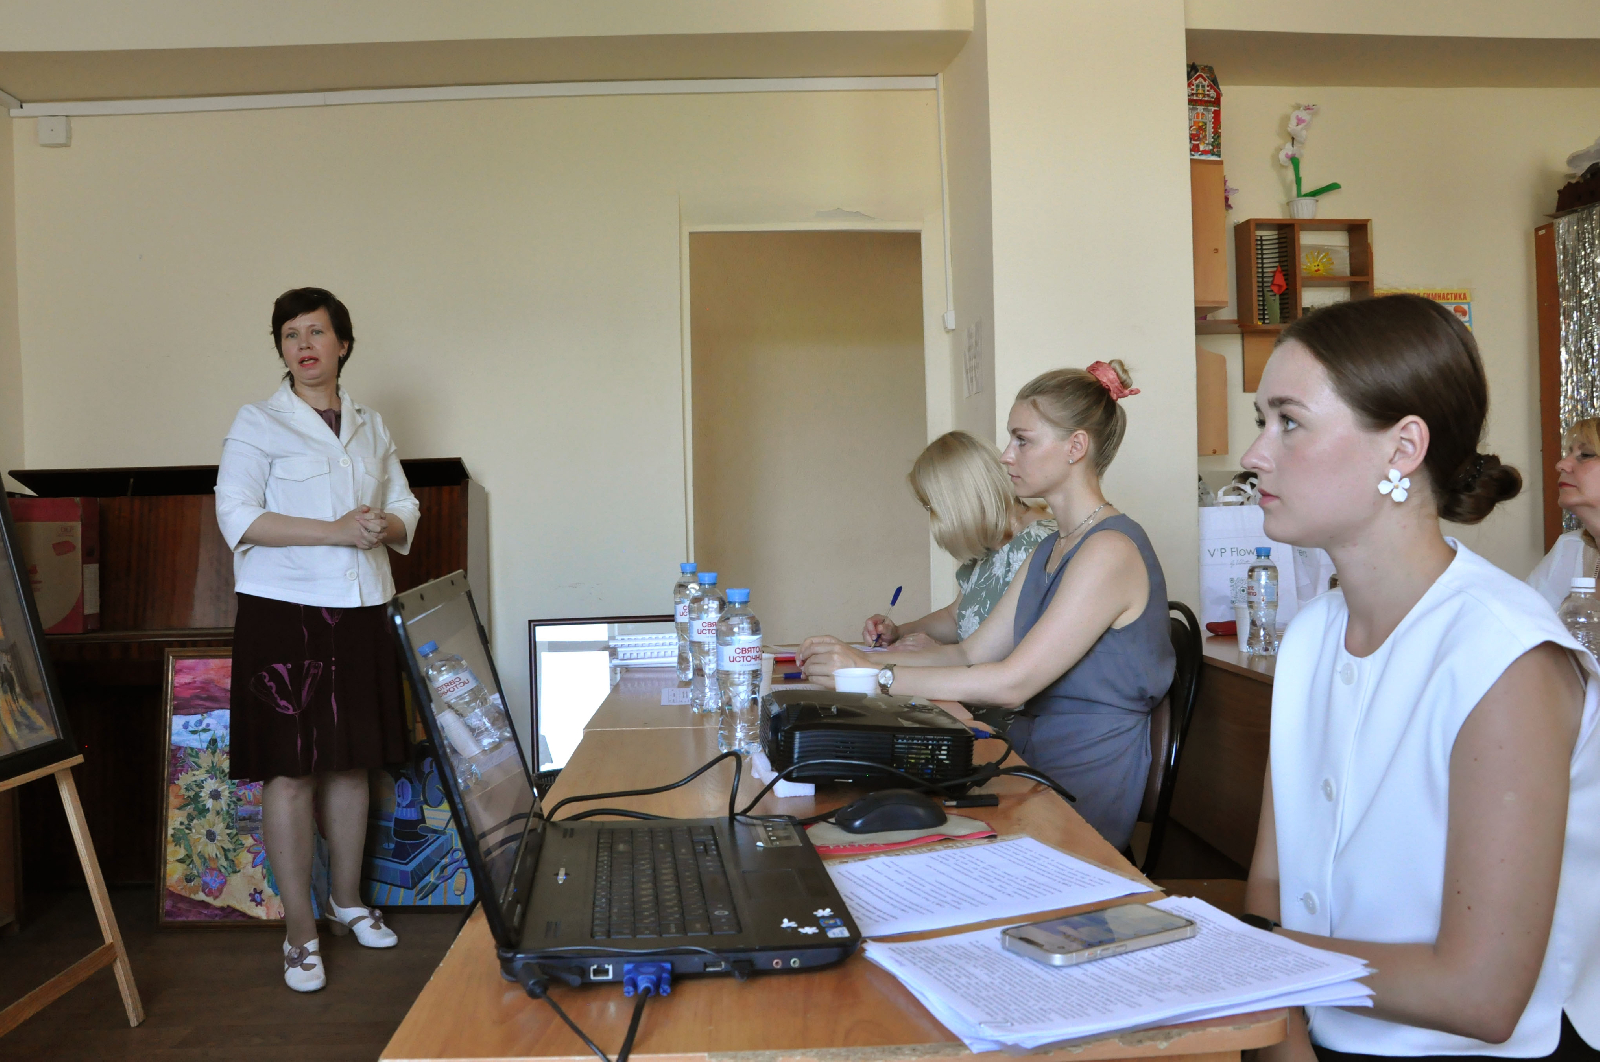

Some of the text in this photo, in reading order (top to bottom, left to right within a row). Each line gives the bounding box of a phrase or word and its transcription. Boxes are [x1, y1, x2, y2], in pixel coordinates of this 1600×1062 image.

[1207, 546, 1256, 558] VP Flow
[734, 646, 761, 655] СВЯТО
